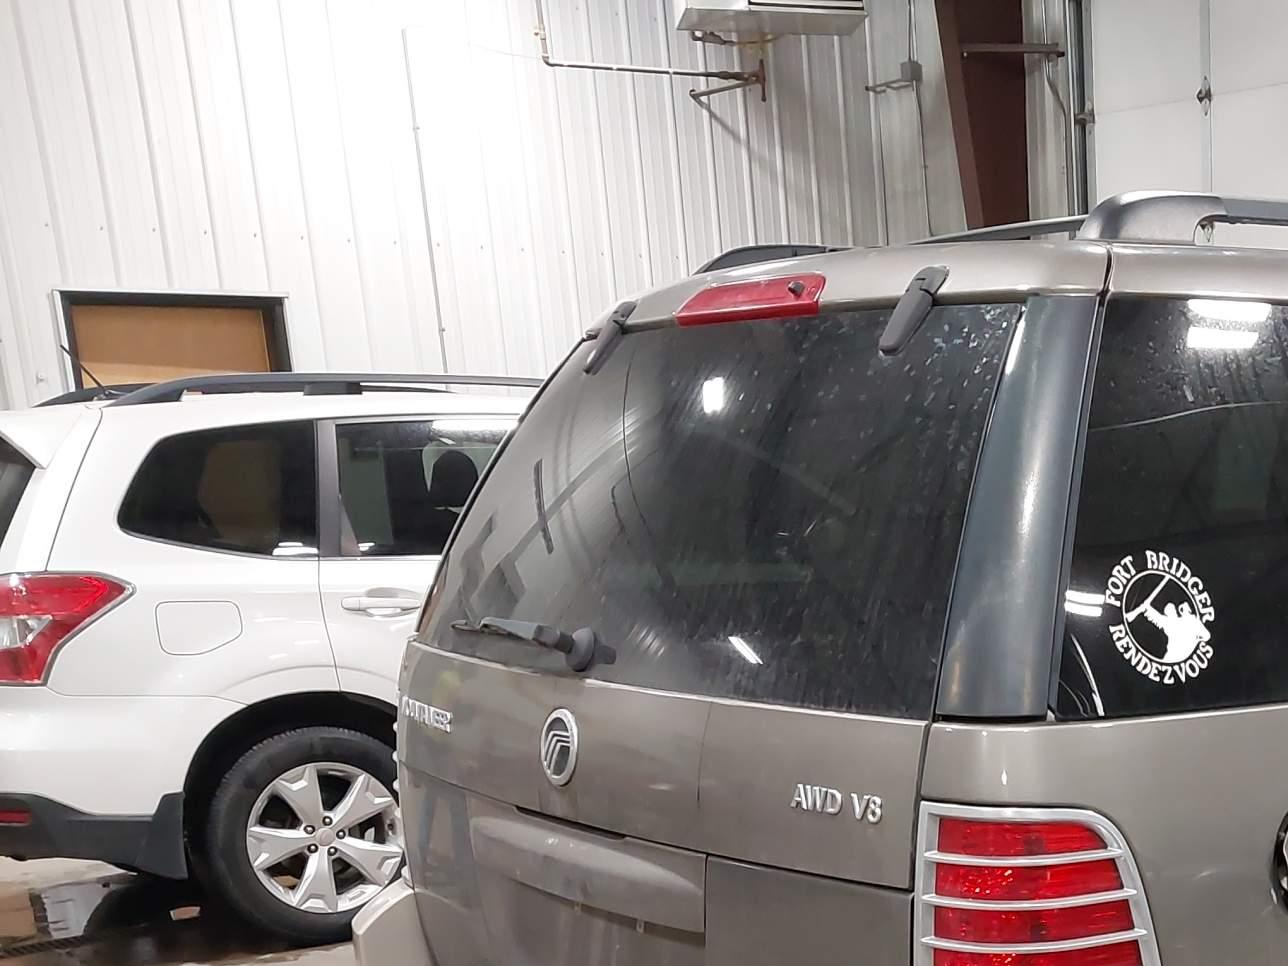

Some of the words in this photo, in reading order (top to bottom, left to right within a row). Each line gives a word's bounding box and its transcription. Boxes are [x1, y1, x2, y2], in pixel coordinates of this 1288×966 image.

[1105, 555, 1137, 607] FORT
[1145, 549, 1215, 623] BRIDGER
[1108, 623, 1214, 685] RENDEZVOUS
[790, 783, 842, 815] AWD
[850, 792, 882, 823] V8
